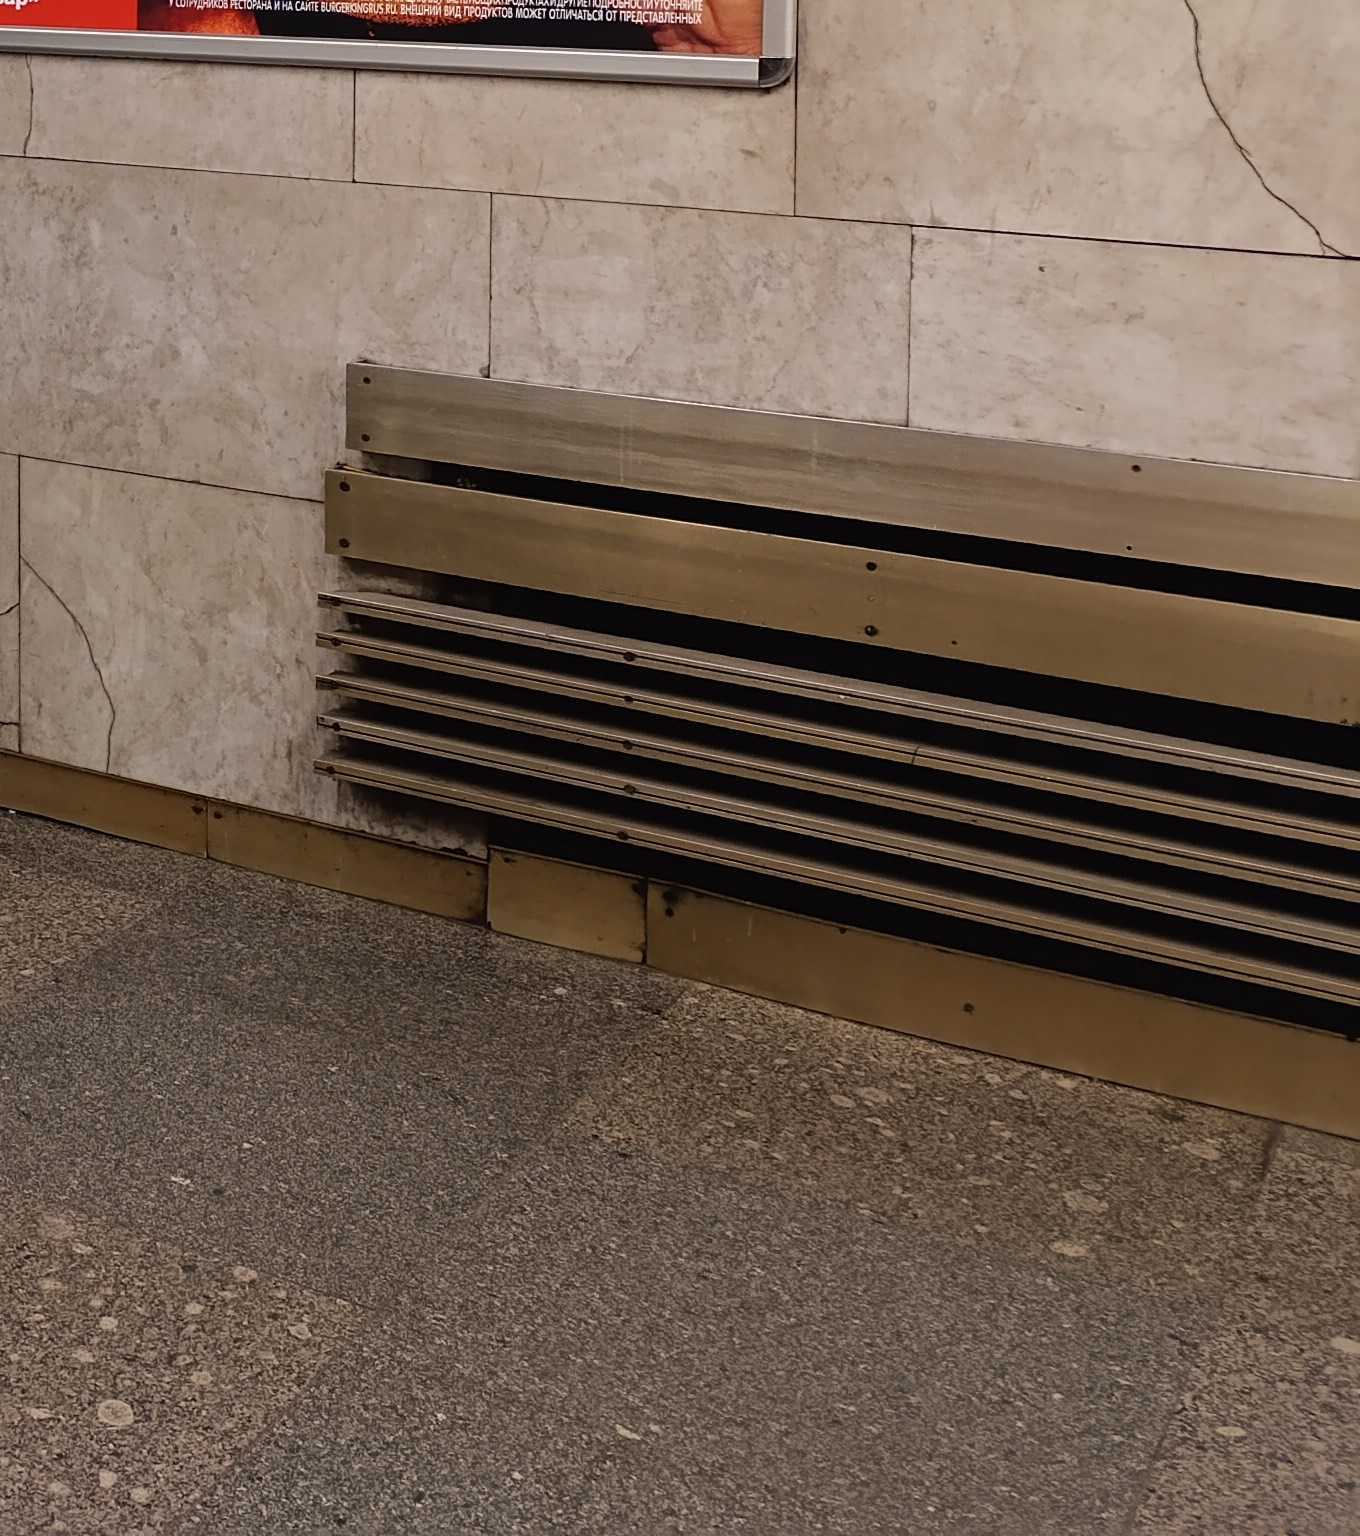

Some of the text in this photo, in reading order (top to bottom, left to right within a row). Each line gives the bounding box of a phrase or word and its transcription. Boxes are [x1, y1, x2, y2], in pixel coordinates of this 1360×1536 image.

[274, 0, 280, 11] И
[281, 0, 293, 11] НА
[463, 5, 514, 19] ПРОДУКТОВ
[515, 7, 547, 20] МОЖЕТ
[548, 8, 604, 21] ОТЛИЧАТЬСЯ
[605, 9, 618, 22] ОТ
[619, 10, 702, 24] ПРЕДСТАВЛЕННЫХ
